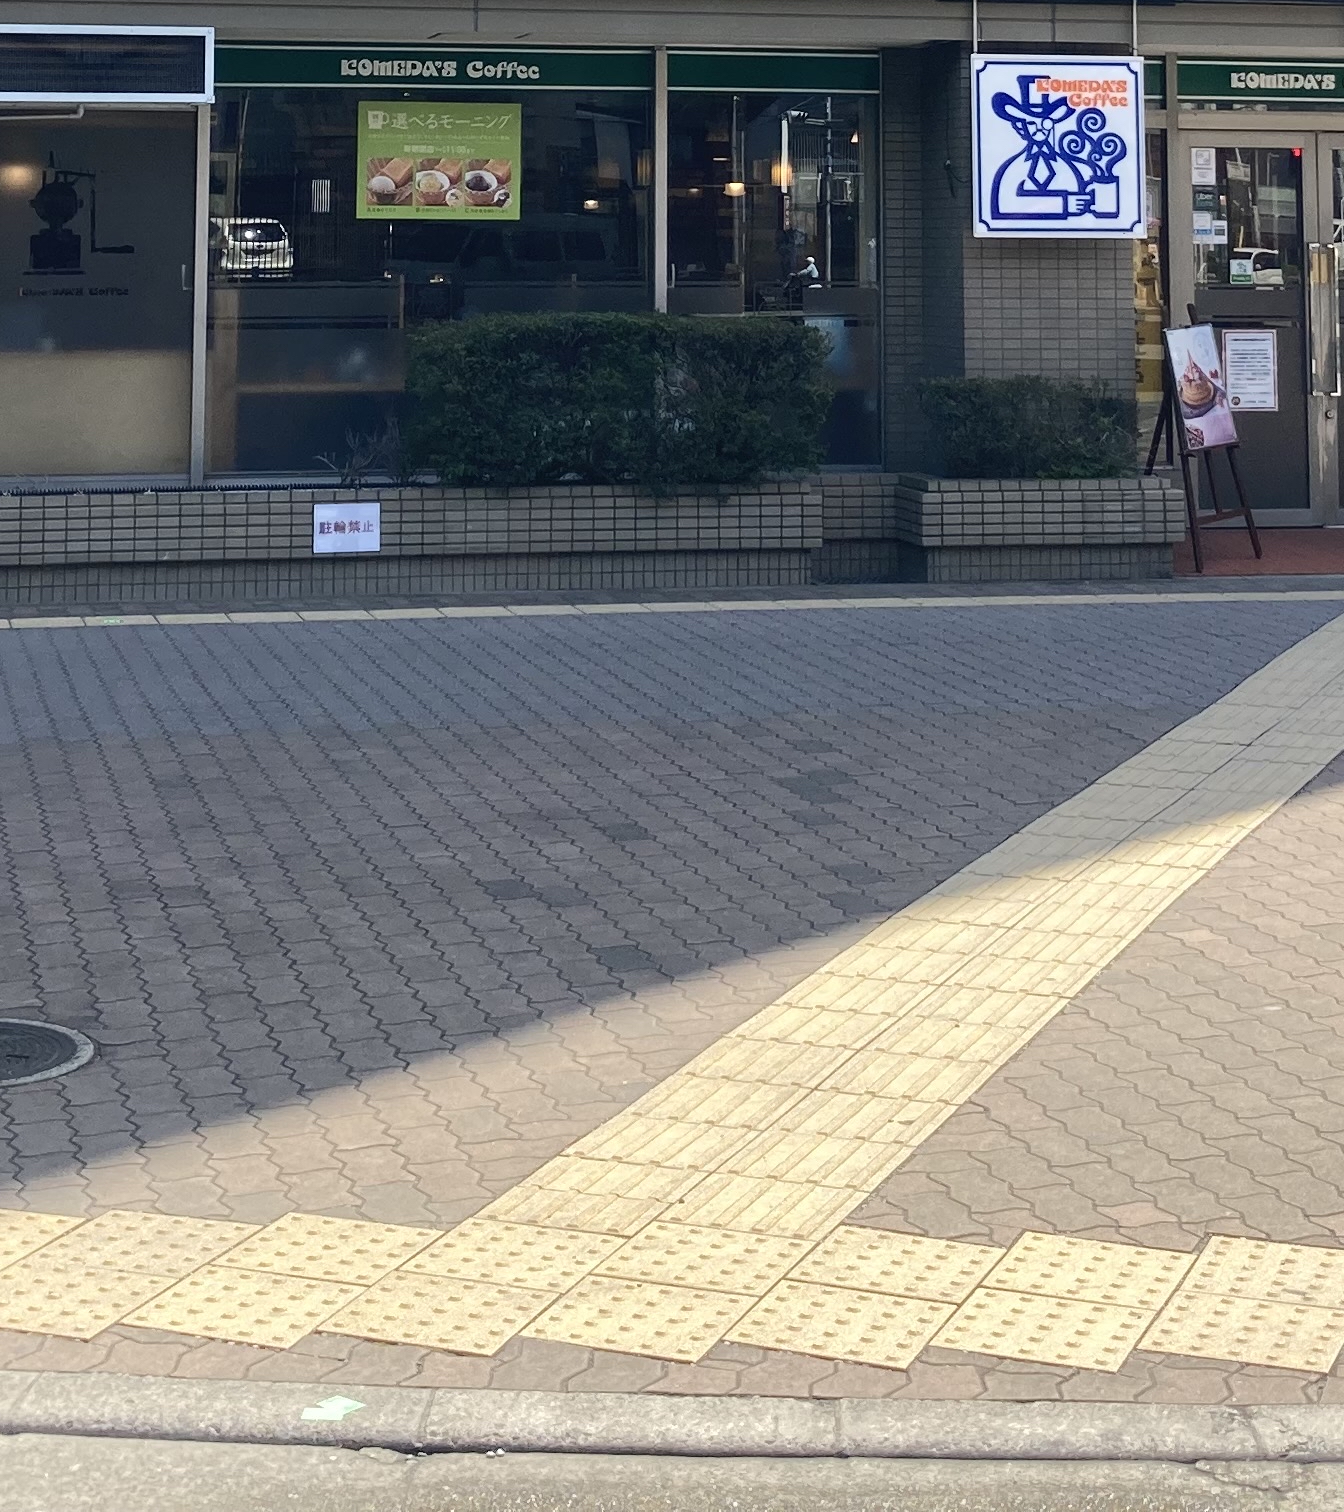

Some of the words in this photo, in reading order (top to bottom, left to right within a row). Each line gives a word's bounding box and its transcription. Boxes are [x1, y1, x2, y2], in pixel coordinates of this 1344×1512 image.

[341, 59, 457, 77] KOMEDA'S
[466, 61, 541, 79] Coffee
[1036, 79, 1127, 93] KOMEDA'S
[1230, 72, 1336, 90] KOMEDA'S
[1068, 93, 1129, 107] Coffee
[391, 112, 513, 130] 選べるモーニング
[318, 519, 375, 535] 駐輪禁止
